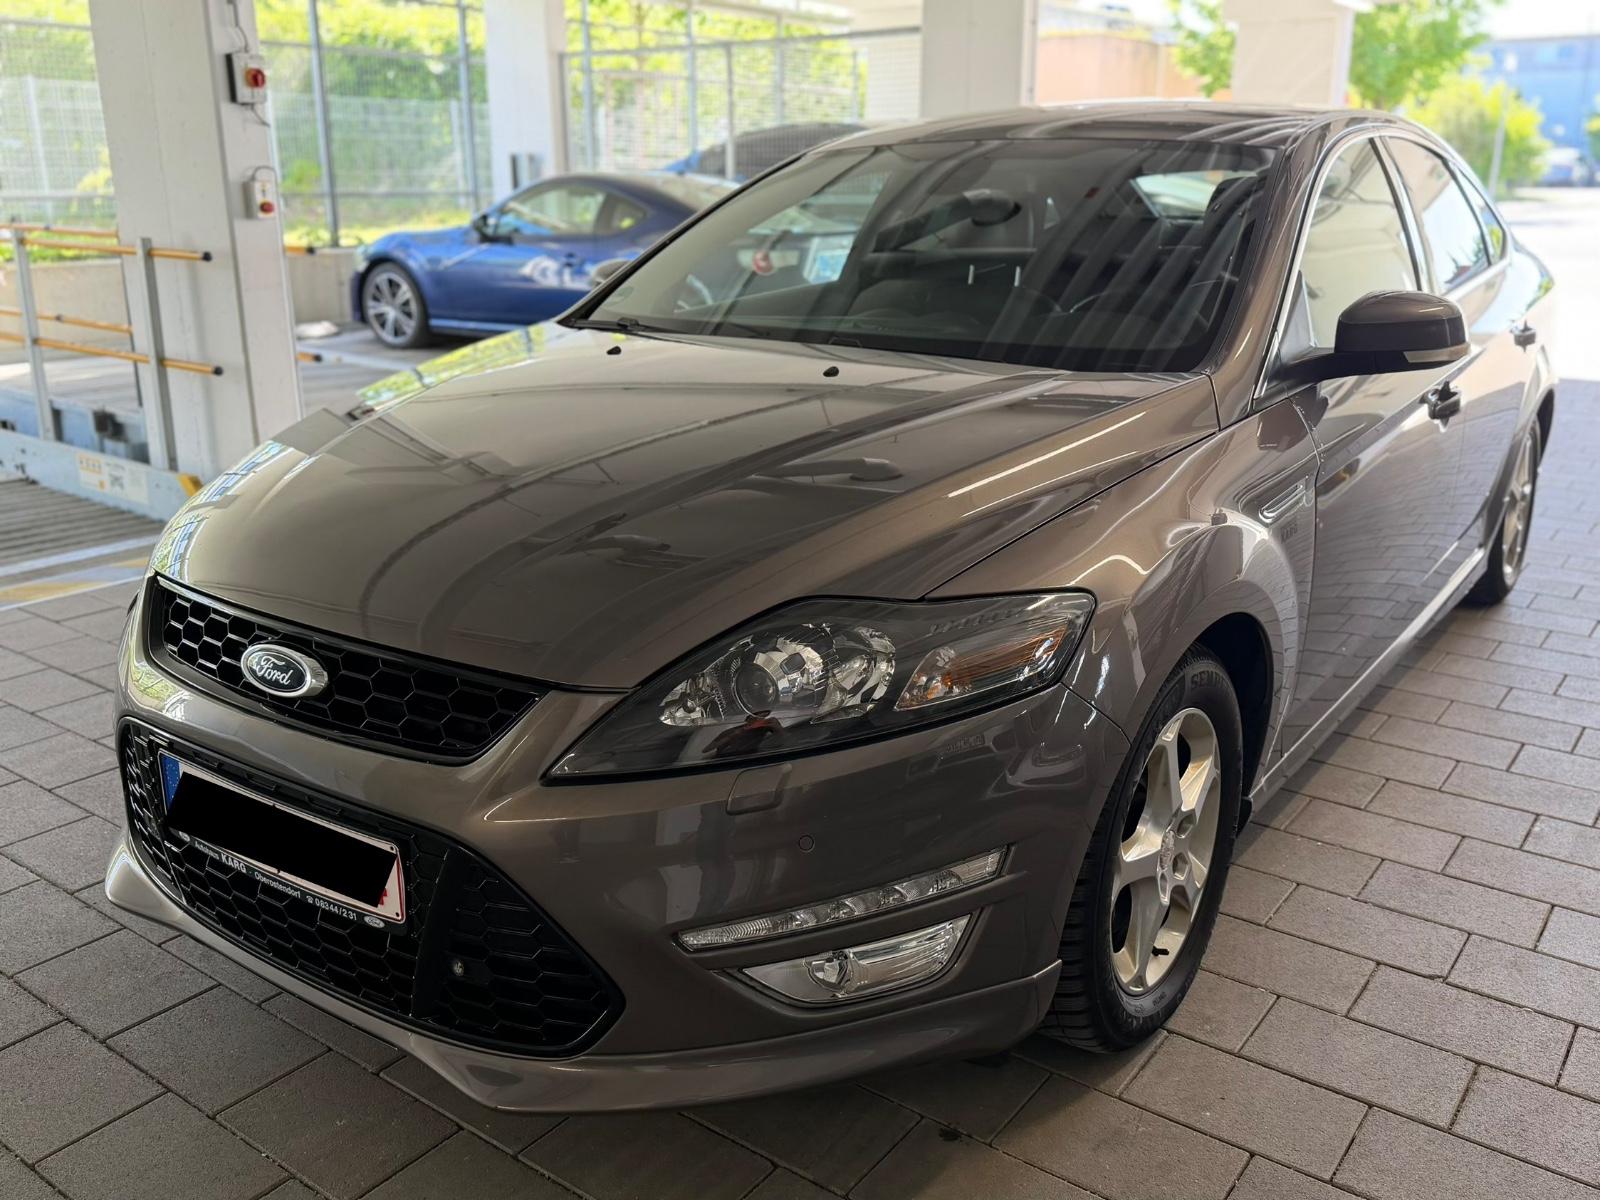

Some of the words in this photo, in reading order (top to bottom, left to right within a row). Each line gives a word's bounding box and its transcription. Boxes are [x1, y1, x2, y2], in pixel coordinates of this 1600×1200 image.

[256, 655, 294, 685] Ford
[221, 852, 247, 874] KARG
[254, 871, 301, 899] Oberostendorf
[315, 897, 357, 921] 08344/231
